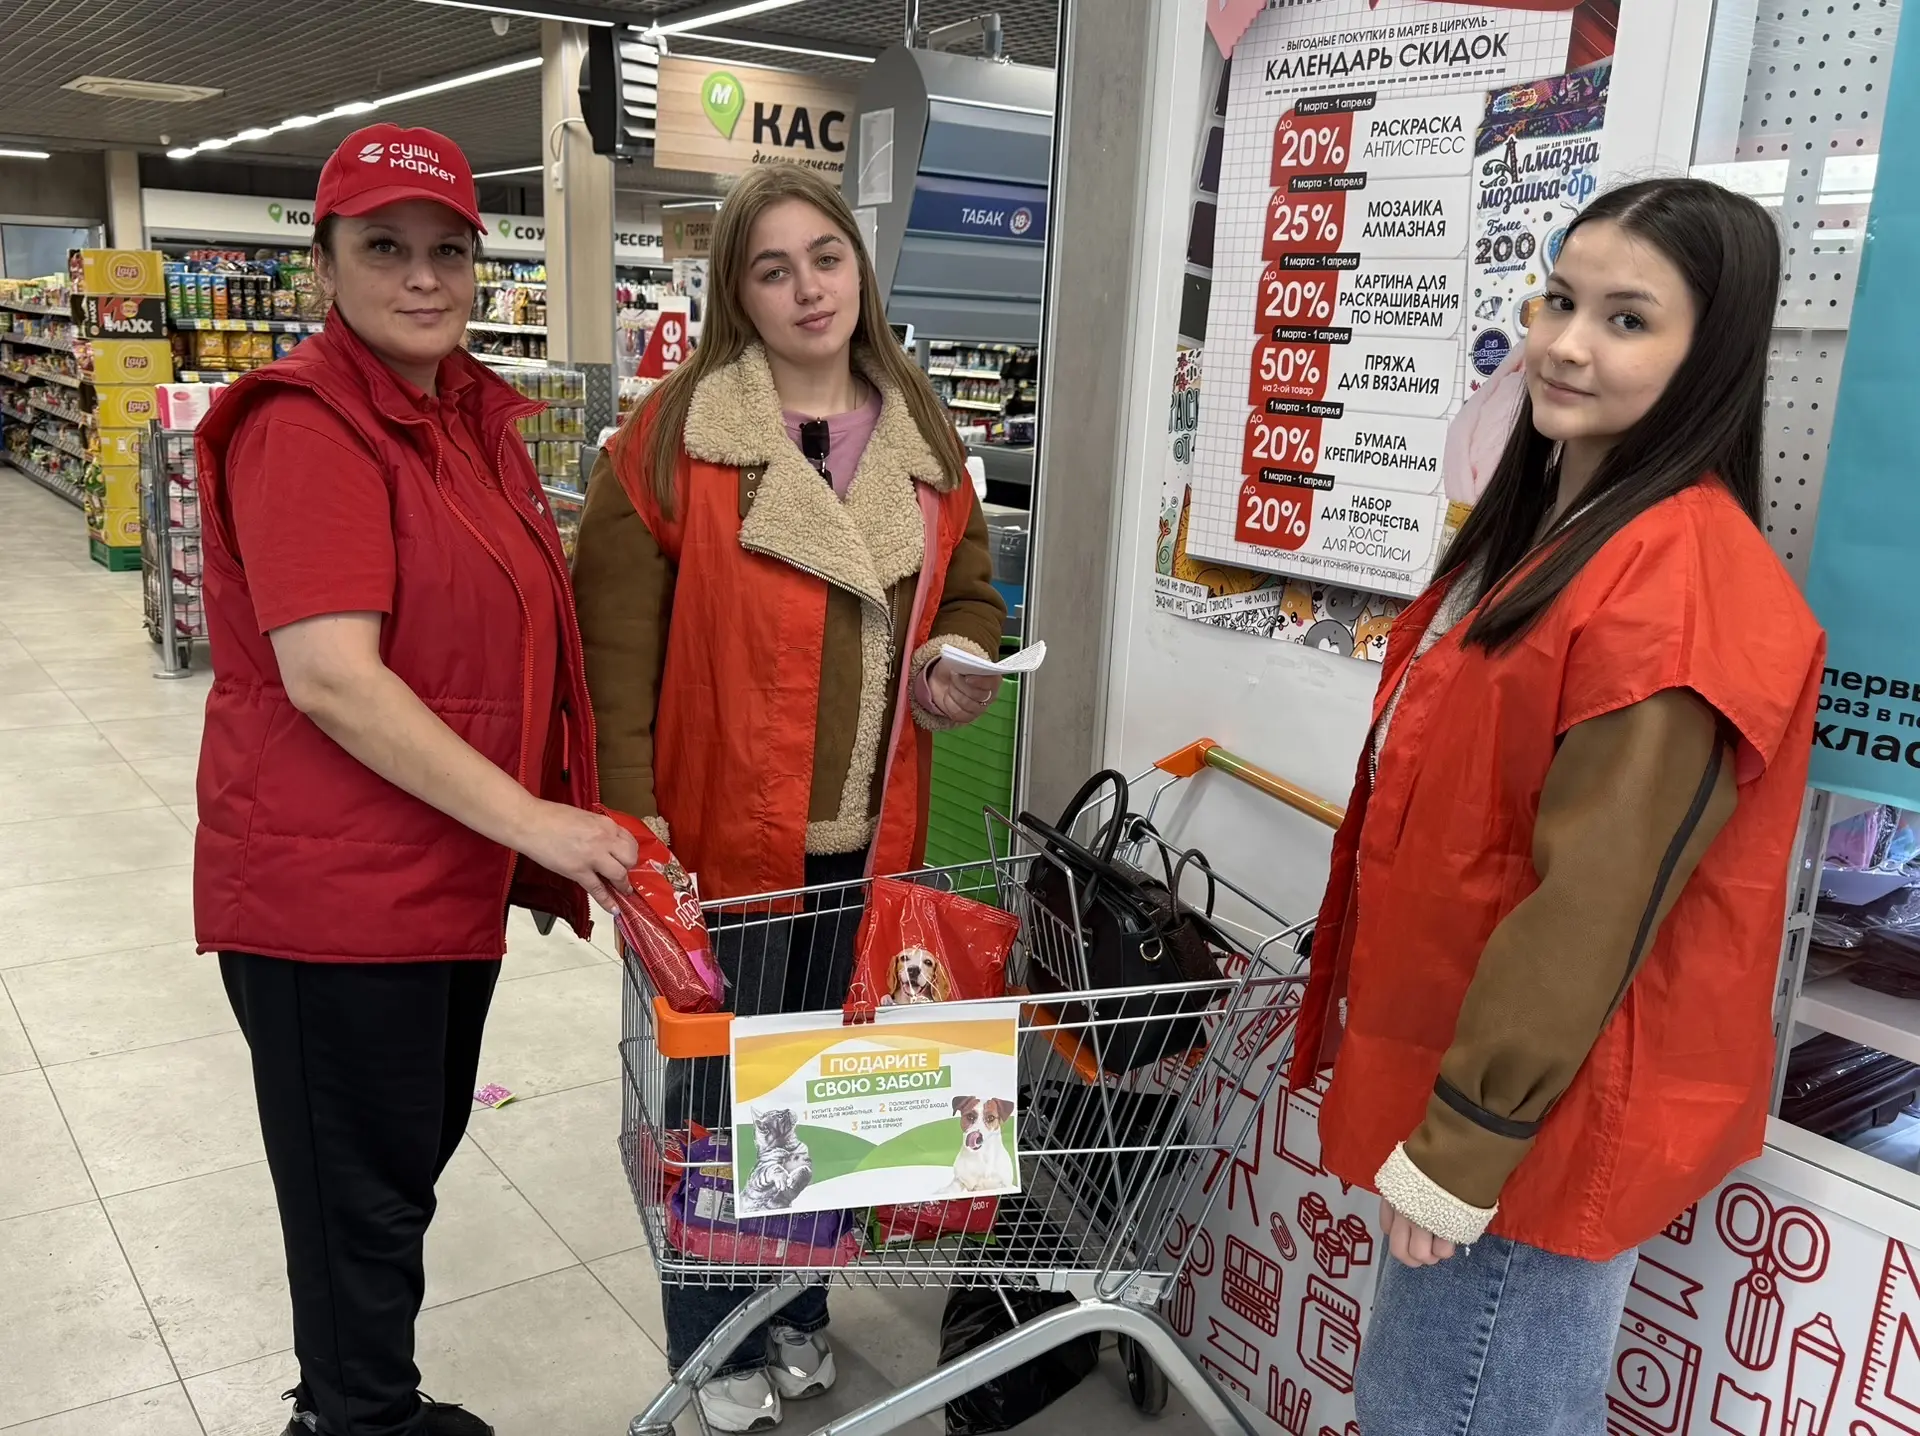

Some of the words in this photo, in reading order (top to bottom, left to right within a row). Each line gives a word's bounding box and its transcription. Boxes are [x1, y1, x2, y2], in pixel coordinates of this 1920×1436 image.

[1287, 35, 1337, 51] ВЫГОДНЫЕ
[1338, 29, 1387, 44] ПОКУПКИ
[1388, 28, 1395, 39] В
[1397, 23, 1430, 38] МАРТЕ
[1431, 22, 1438, 34] В
[1440, 16, 1488, 33] ЦИРКУЛЬ
[1265, 47, 1393, 81] КАЛЕНДАРЬ
[1399, 33, 1509, 67] СКИДОК
[1298, 102, 1303, 112] 1
[1304, 101, 1329, 112] марта
[1336, 99, 1340, 109] 1
[1340, 98, 1372, 110] апреля
[1370, 116, 1462, 137] РАСКРАСКА
[1280, 127, 1345, 167] 20%
[1363, 136, 1466, 159] АНТИСТРЕСС
[1480, 135, 1600, 188] Алмазна
[1292, 179, 1297, 188] 1
[1297, 178, 1322, 190] марта
[1328, 177, 1333, 187] 1
[1334, 176, 1363, 188] апреля
[286, 210, 315, 225] КО
[961, 208, 1004, 226] ТАБАК
[1368, 200, 1443, 218] МОЗАИКА
[1272, 203, 1338, 242] 25%
[1362, 221, 1446, 238] АЛМАЗНАЯ
[1475, 232, 1536, 265] 200
[1283, 257, 1288, 266] 1
[1289, 257, 1315, 268] марта
[1322, 257, 1326, 266] 1
[1327, 257, 1357, 268] апреля
[1355, 274, 1414, 290] КАРТИНА
[1416, 275, 1447, 291] ДЛЯ
[1265, 281, 1330, 319] 20%
[1339, 292, 1459, 309] РАСКРАШИВАНИЯ
[1351, 310, 1371, 324] ПО
[1373, 311, 1443, 327] НОМЕРАМ
[1275, 329, 1280, 339] 1
[1281, 330, 1306, 340] марта
[1313, 330, 1318, 339] 1
[1319, 331, 1349, 341] апреля
[1259, 347, 1320, 384] 50%
[1365, 355, 1416, 373] ПРЯЖА
[1262, 385, 1272, 393] на
[1273, 384, 1289, 394] 2-ой
[1291, 387, 1313, 396] товар
[1338, 373, 1369, 390] ДЛЯ
[1373, 376, 1440, 395] ВЯЗАНИЯ
[1269, 401, 1274, 410] 1
[1275, 402, 1300, 413] марта
[1306, 403, 1311, 413] 1
[1311, 404, 1340, 416] апреля
[1252, 425, 1314, 464] 20%
[1355, 432, 1407, 451] БУМАГА
[1324, 447, 1437, 472] КРЕПИРОВАННАЯ
[1263, 471, 1268, 480] 1
[1269, 472, 1292, 483] марта
[1298, 475, 1303, 484] 1
[1303, 476, 1332, 488] апреля
[1351, 495, 1392, 512] НАБОР
[1245, 495, 1306, 537] 20%
[1321, 506, 1346, 521] ДЛЯ
[1349, 510, 1419, 532] ТВОРЧЕСТВА
[1347, 525, 1388, 543] ХОЛСТ
[1322, 536, 1347, 551] ДЛЯ
[1349, 539, 1411, 562] РОСПИСИ
[1816, 694, 1870, 718] раз
[1876, 708, 1891, 722] в
[830, 1053, 928, 1073] ПОДАРИТЕ
[813, 1078, 871, 1098] СВОЮ
[875, 1070, 944, 1091] ЗАБОТУ
[803, 1111, 808, 1120] 1
[879, 1103, 886, 1113] 2
[851, 1121, 858, 1131] 3
